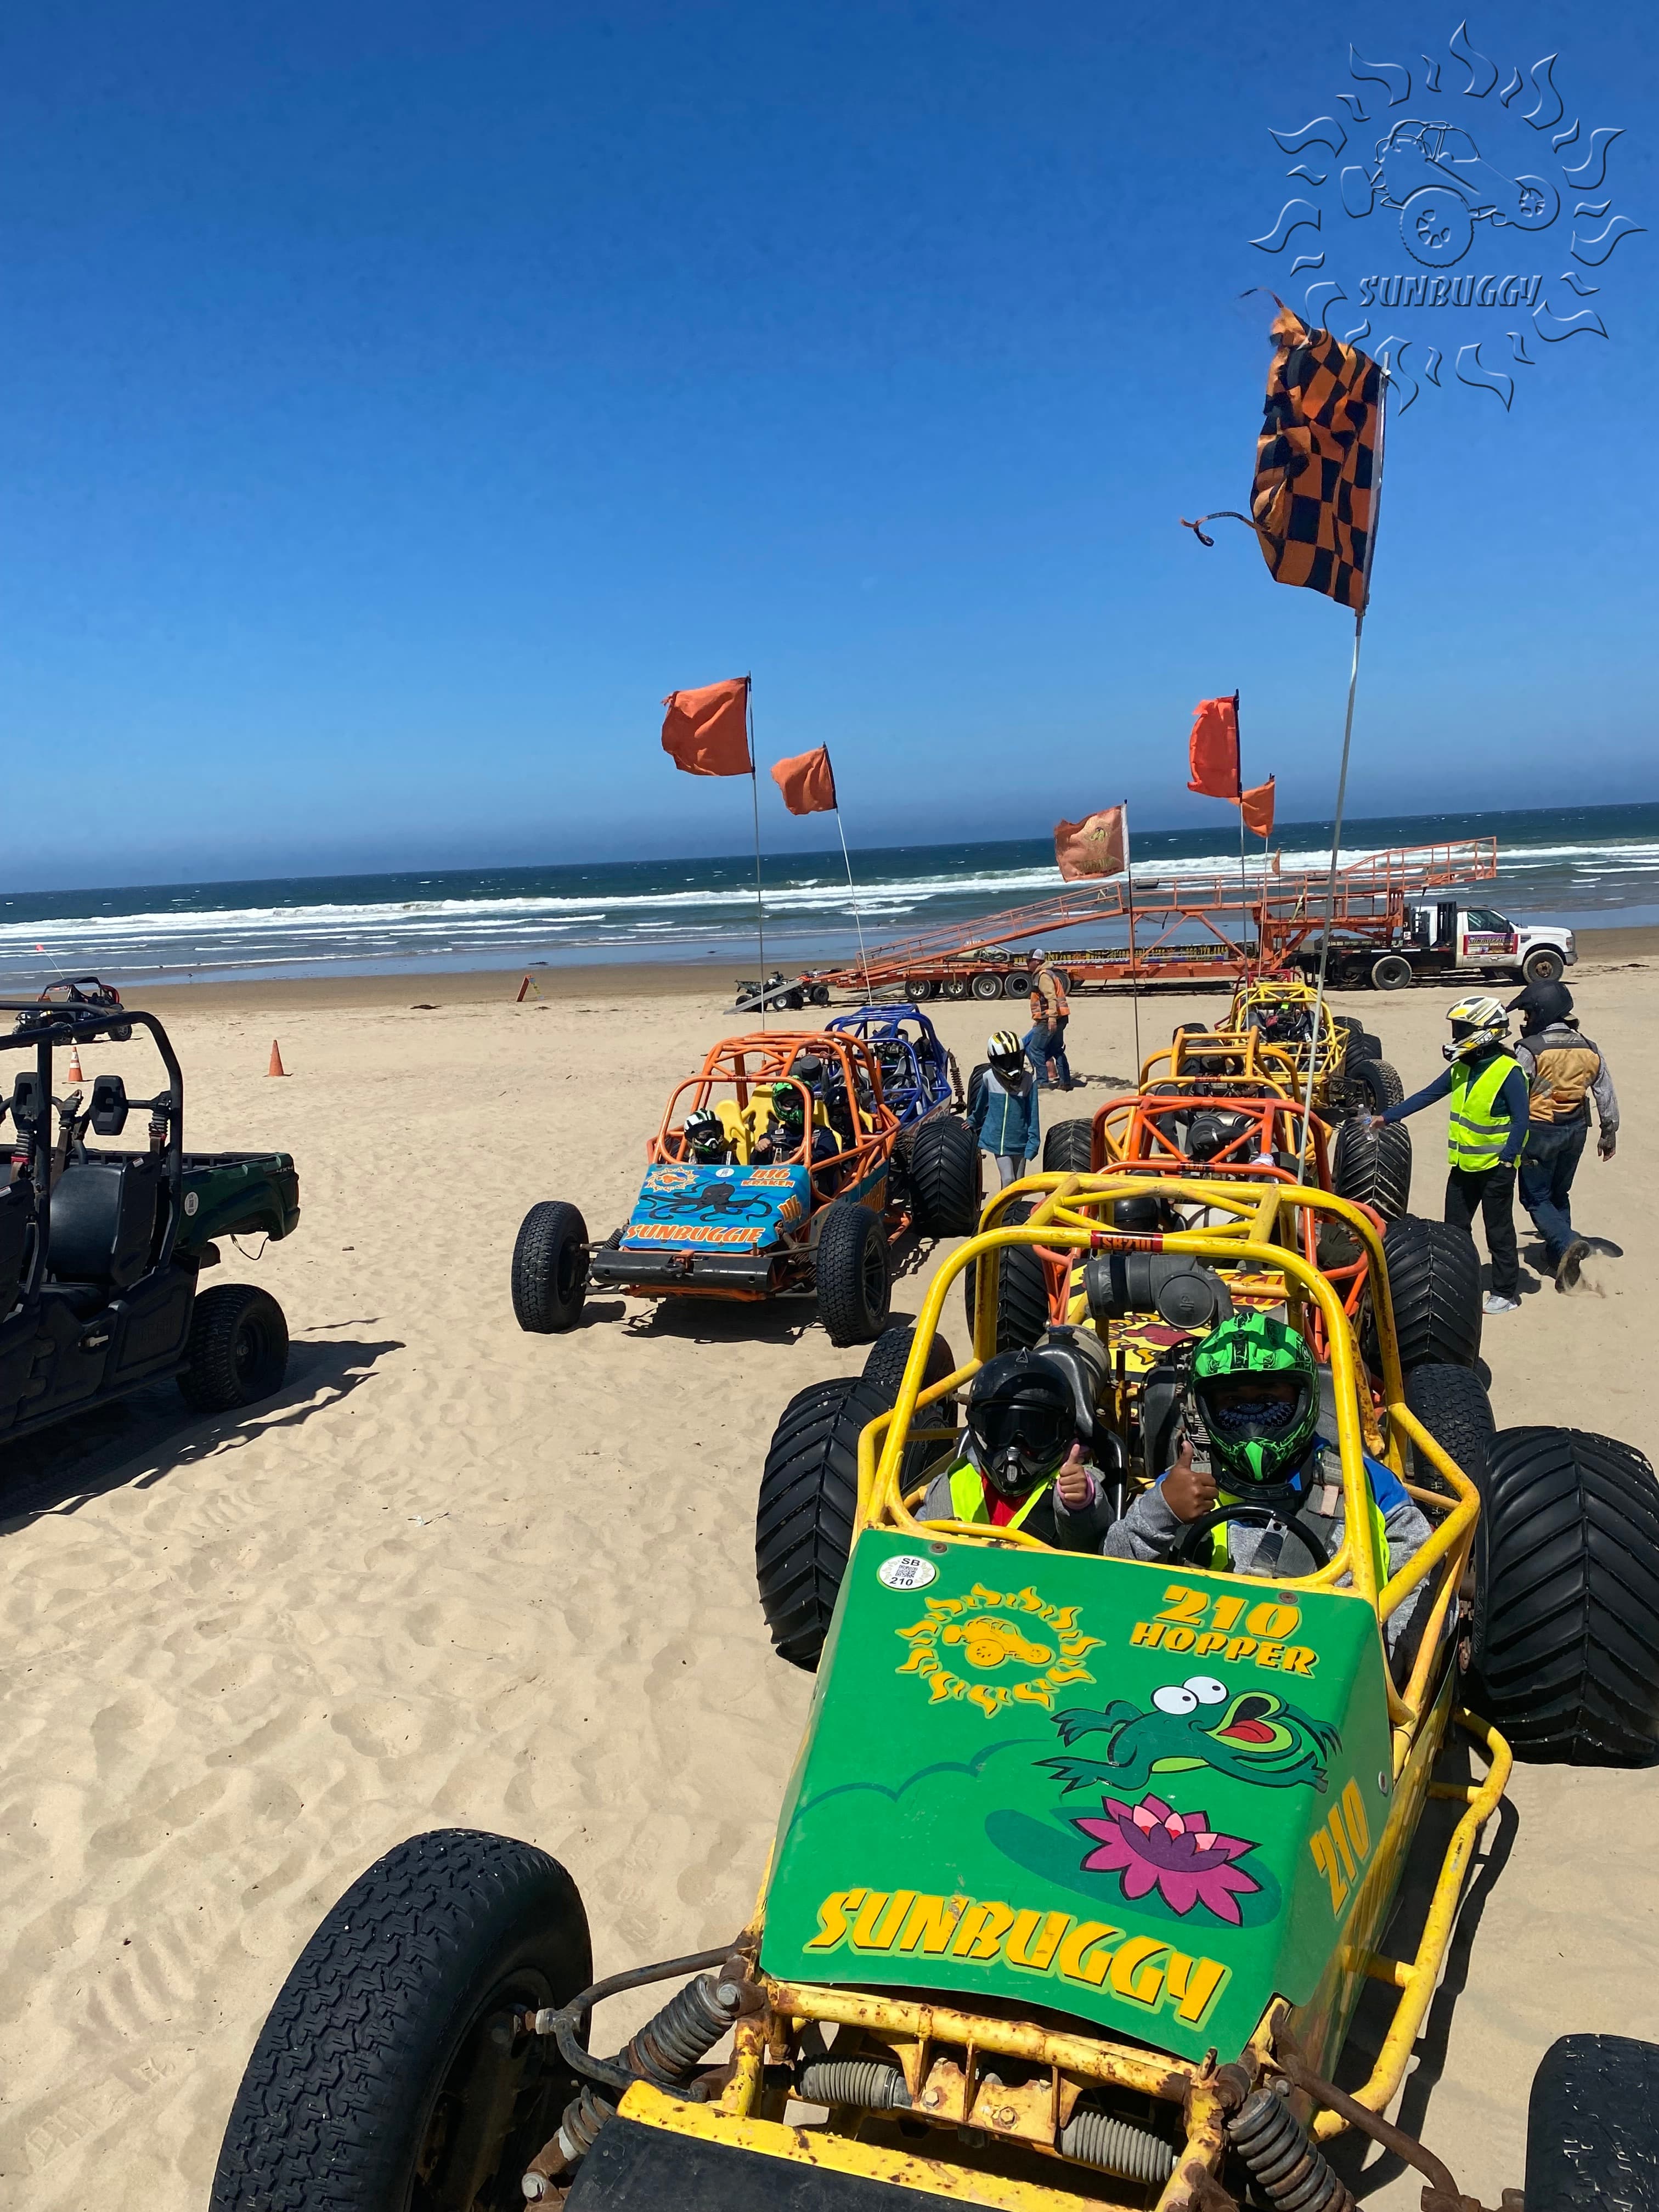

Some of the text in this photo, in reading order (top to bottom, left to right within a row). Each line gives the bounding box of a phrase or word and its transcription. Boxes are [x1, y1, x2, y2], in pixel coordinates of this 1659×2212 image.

[749, 1168, 791, 1180] 416
[626, 1224, 766, 1243] SUNBUGGIE
[901, 1558, 920, 1566] SB
[889, 1577, 913, 1586] 210
[1153, 1584, 1303, 1641] 210
[1130, 1622, 1319, 1679] HOPPER
[1309, 1775, 1371, 1920] 210
[804, 1888, 1232, 2031] SUNBUGGY
